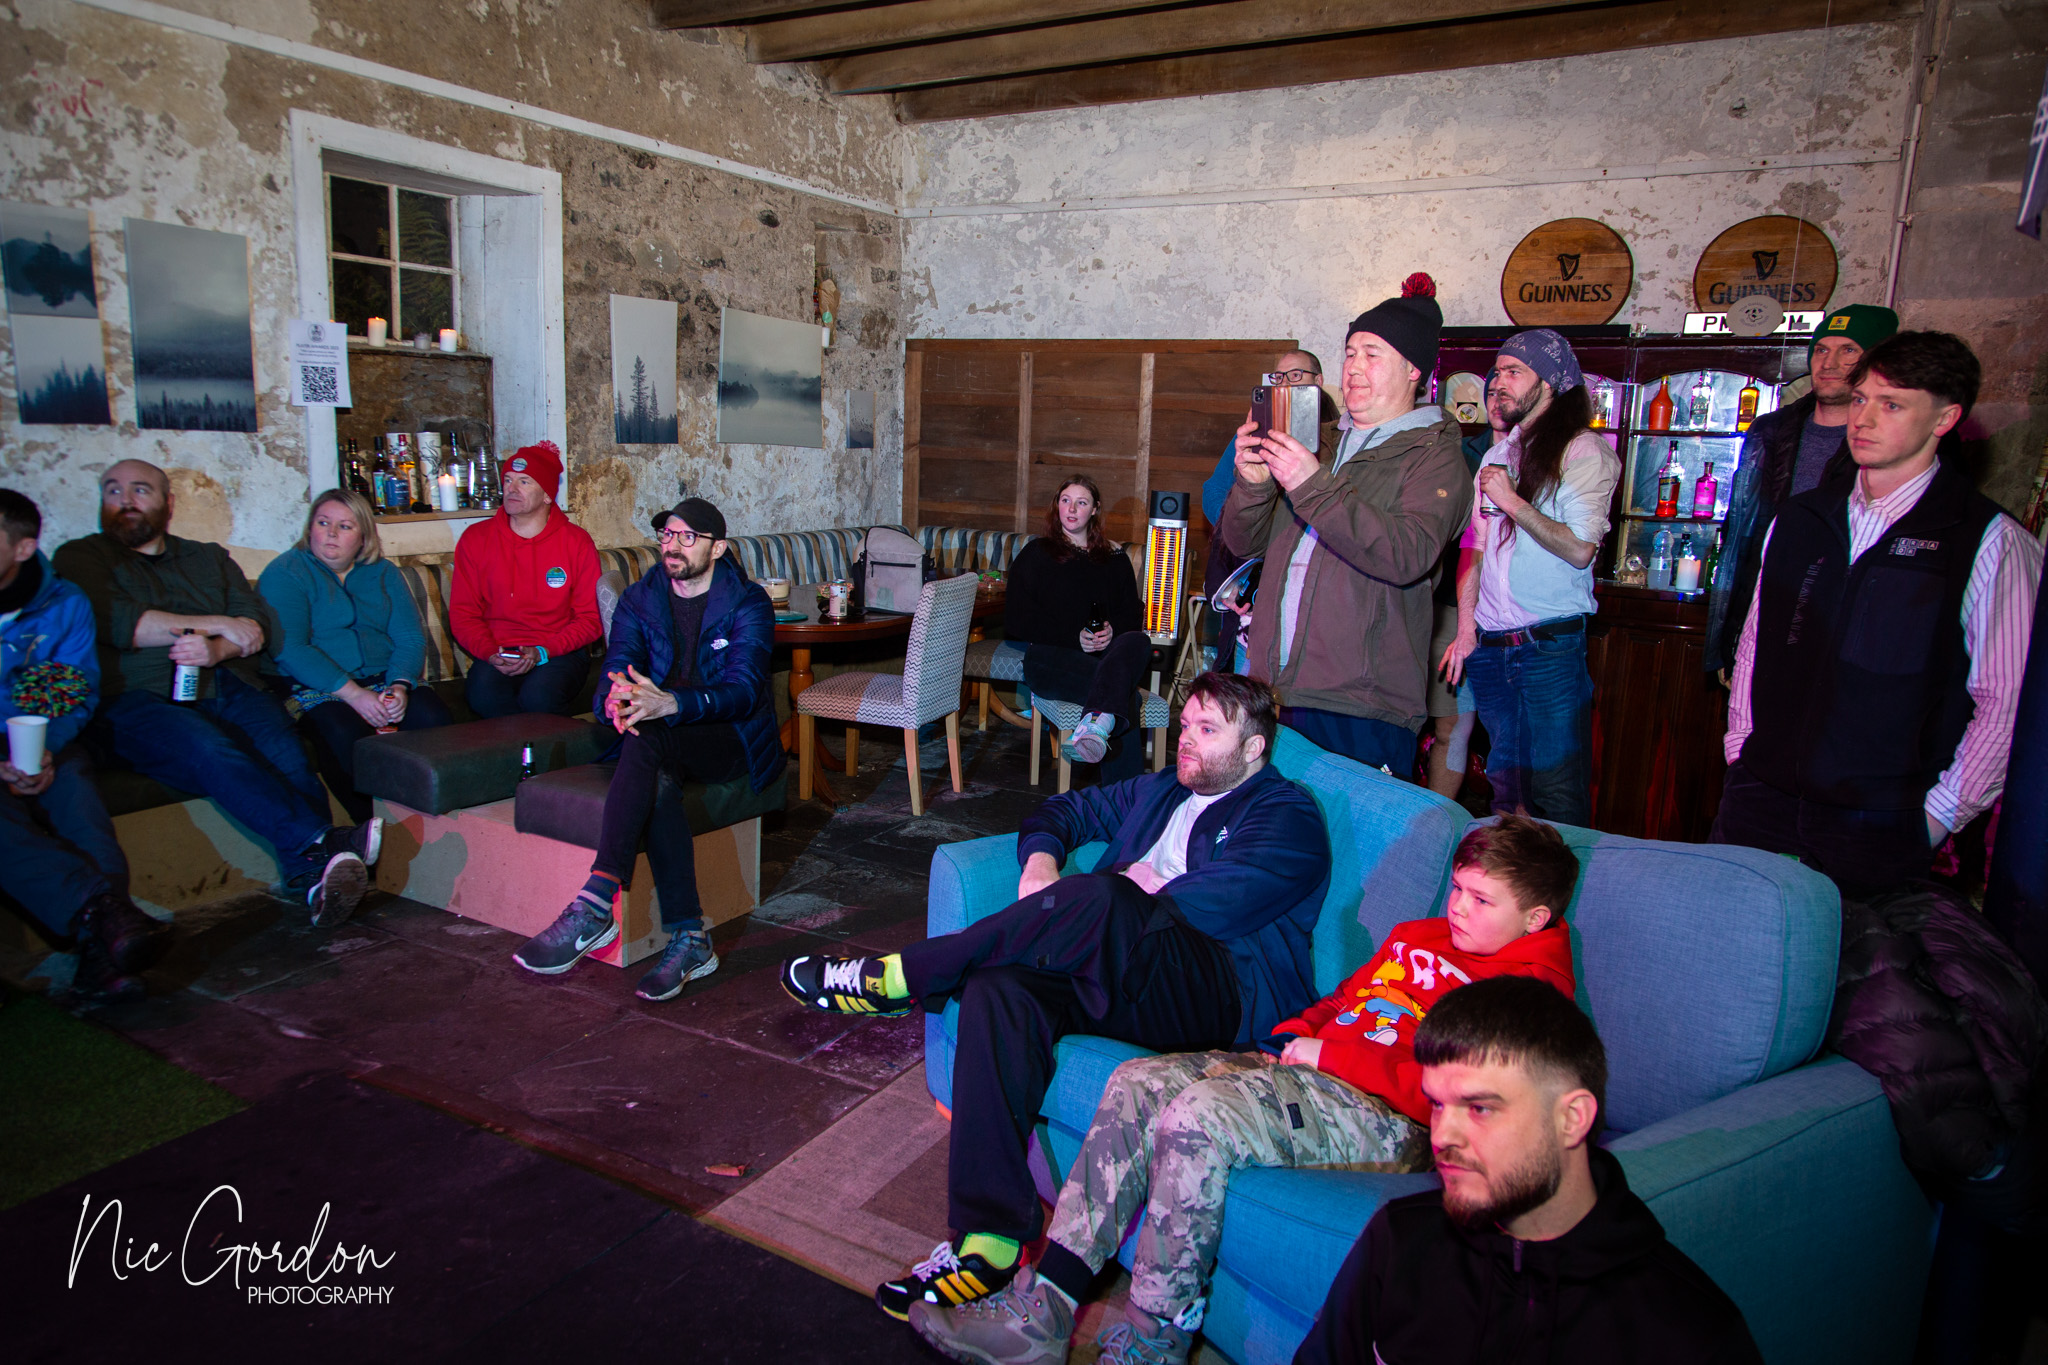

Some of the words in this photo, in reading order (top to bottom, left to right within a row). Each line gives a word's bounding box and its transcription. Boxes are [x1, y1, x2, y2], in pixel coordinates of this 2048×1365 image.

[1518, 282, 1613, 303] GUINNESS
[1708, 281, 1817, 305] GUINNESS
[182, 673, 191, 697] LUCKY
